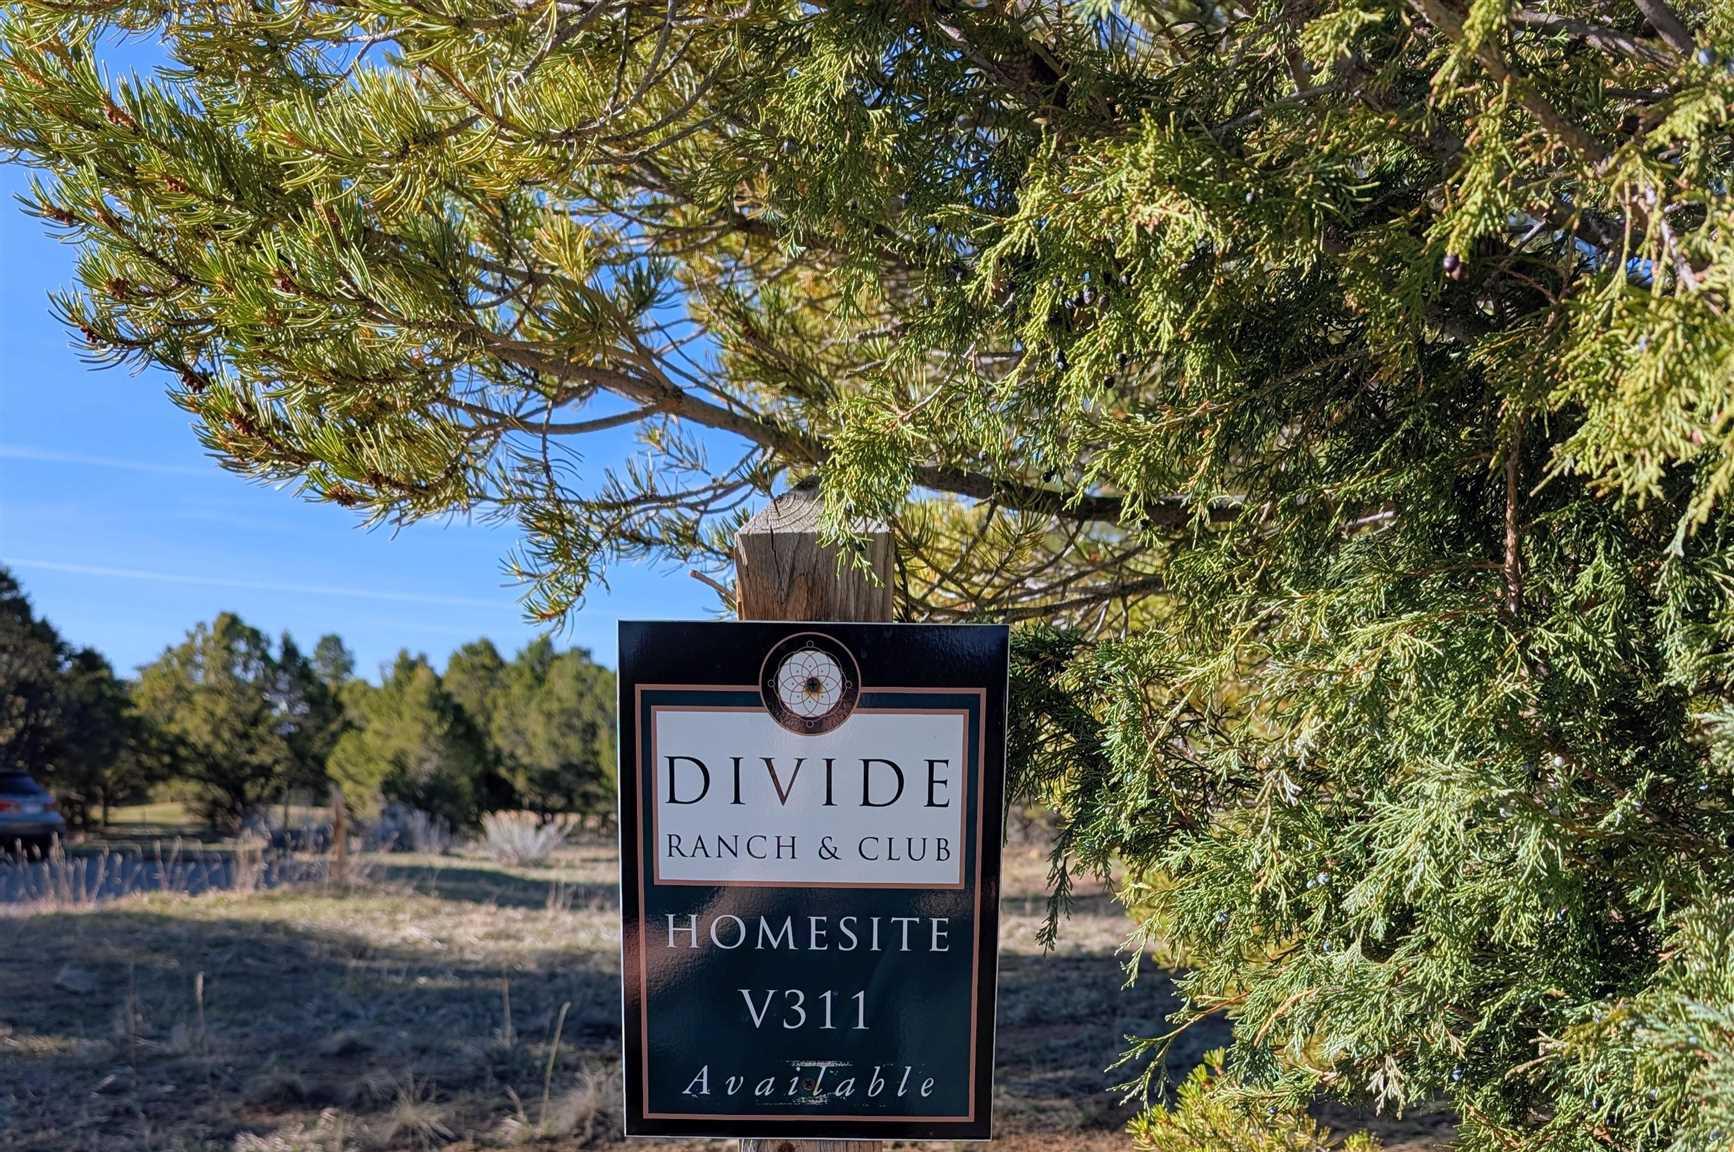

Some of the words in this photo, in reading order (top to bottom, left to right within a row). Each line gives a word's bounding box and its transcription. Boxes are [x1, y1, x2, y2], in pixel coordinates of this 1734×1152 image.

[664, 756, 951, 808] DIVIDE
[666, 834, 798, 860] RANCH
[818, 836, 842, 861] &
[858, 836, 952, 862] CLUB
[666, 913, 951, 952] HOMESITE
[738, 989, 870, 1030] V311
[682, 1063, 936, 1098] Available
